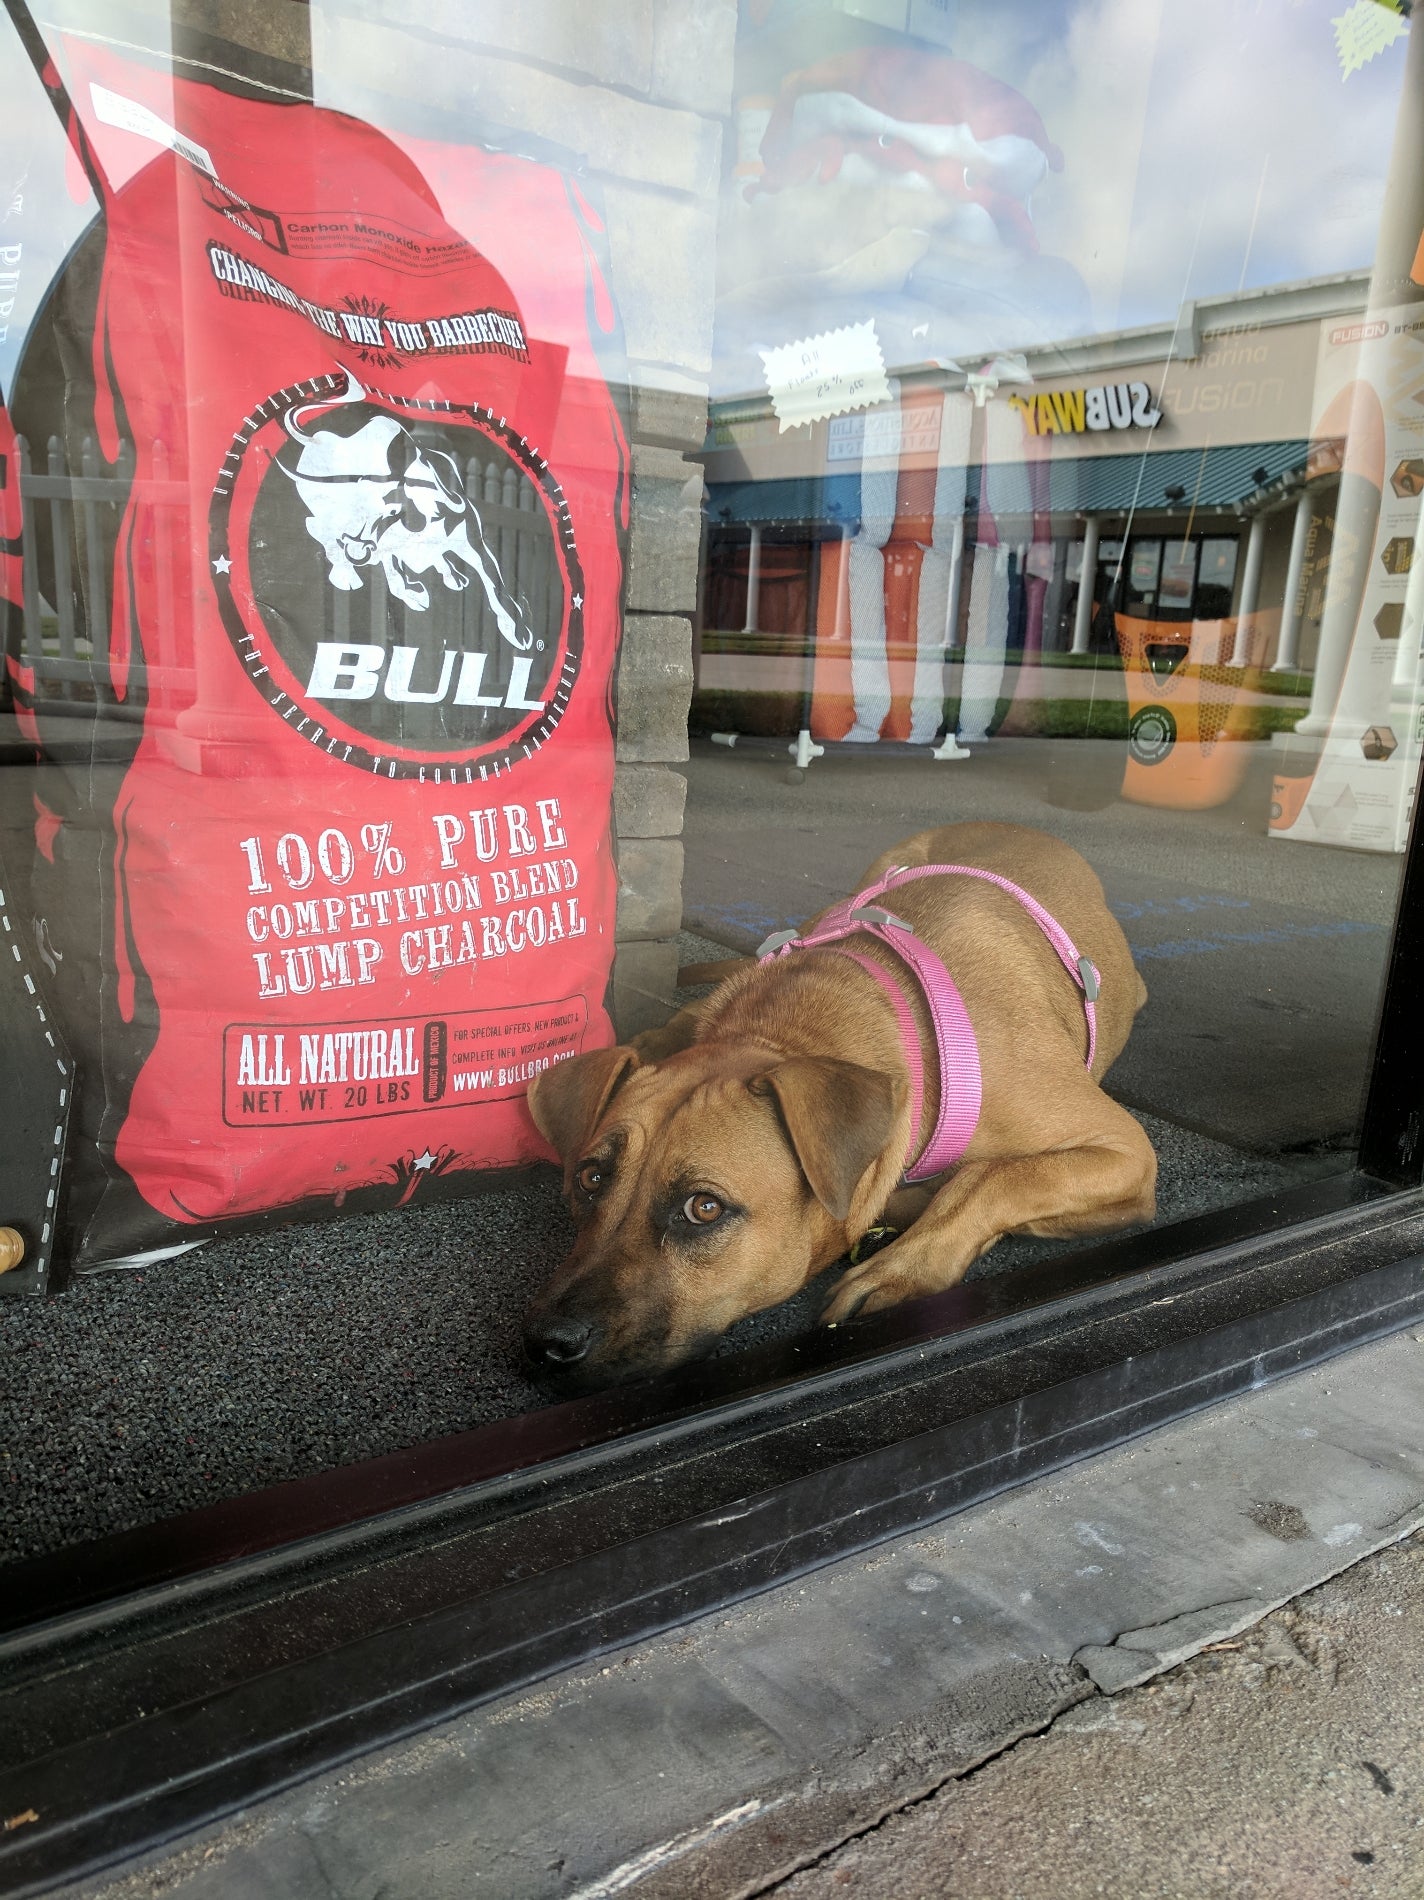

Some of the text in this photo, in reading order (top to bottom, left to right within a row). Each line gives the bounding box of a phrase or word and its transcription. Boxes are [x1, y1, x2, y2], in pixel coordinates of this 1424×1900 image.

[287, 222, 349, 234] Carbon
[354, 223, 422, 254] Monoxide
[210, 247, 307, 316] CHANGING
[301, 298, 342, 338] THE
[340, 313, 385, 347] WAY
[384, 320, 427, 351] YOU
[426, 312, 527, 350] BARBECUE!
[1332, 323, 1387, 345] FUSION
[213, 374, 335, 495] UNSURPASSED
[473, 401, 507, 428] YOU
[520, 435, 549, 469] CAN
[553, 484, 577, 549] TASTE
[238, 633, 578, 785] THE SECRET TO GOURMET BARBECUE!
[304, 642, 546, 712] BULL
[240, 798, 568, 895] 100% PURE
[246, 858, 579, 943] COMPETITION BLEND
[252, 897, 587, 1000] LUMP CHARCOAL
[237, 1027, 420, 1086] ALL NATURAL
[428, 1026, 440, 1099] PRODUCT OF MEXICO
[452, 1049, 495, 1065] COMPLETE
[453, 1029, 468, 1041] FOR
[471, 1026, 501, 1040] SPECIAL
[534, 1017, 549, 1031] NEW
[550, 1014, 574, 1028] PRODUCT
[241, 1080, 411, 1114] NET. WT. 20 LBS
